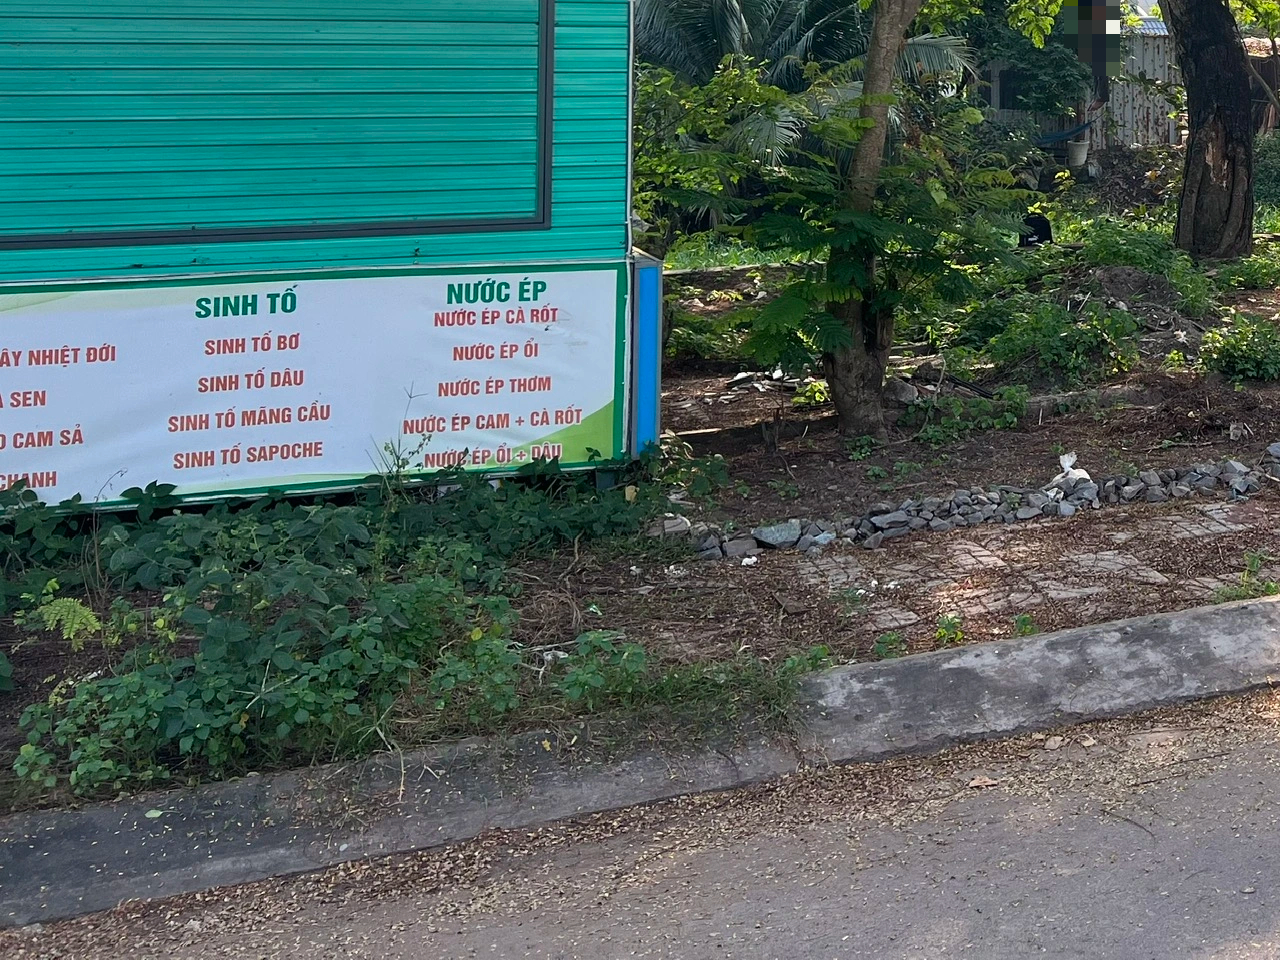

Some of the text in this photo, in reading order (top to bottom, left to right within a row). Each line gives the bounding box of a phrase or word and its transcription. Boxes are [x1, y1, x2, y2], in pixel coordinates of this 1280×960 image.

[195, 284, 299, 318] SINH TỐ
[446, 277, 547, 304] NƯỚC ÉP
[434, 303, 559, 327] NƯỚC ÉP CÀ RỐT
[28, 345, 80, 368] NHIỆT
[86, 343, 116, 363] ĐỚI
[204, 330, 300, 356] SINH TỐ BƠ
[453, 337, 539, 361] NƯỚC ÉP ỔI
[198, 367, 304, 393] SINH TỐ DÂU
[438, 376, 552, 397] NƯỚC ÉP THƠM
[10, 390, 46, 408] SEN
[168, 400, 331, 433] SINH TỐ MÃNG CẦU
[403, 414, 446, 434] NƯỚC
[451, 412, 471, 431] ÉP
[475, 413, 510, 430] CAM
[530, 408, 551, 427] CÀ
[554, 403, 583, 424] RỐT
[13, 431, 53, 449] CAM
[59, 423, 84, 446] SẢ
[173, 442, 324, 470] SINH TỐ SAPOCHE
[424, 448, 467, 468] NƯỚC
[472, 446, 492, 465] ÉP
[496, 442, 512, 463] ỔI
[531, 442, 562, 460] DÂU
